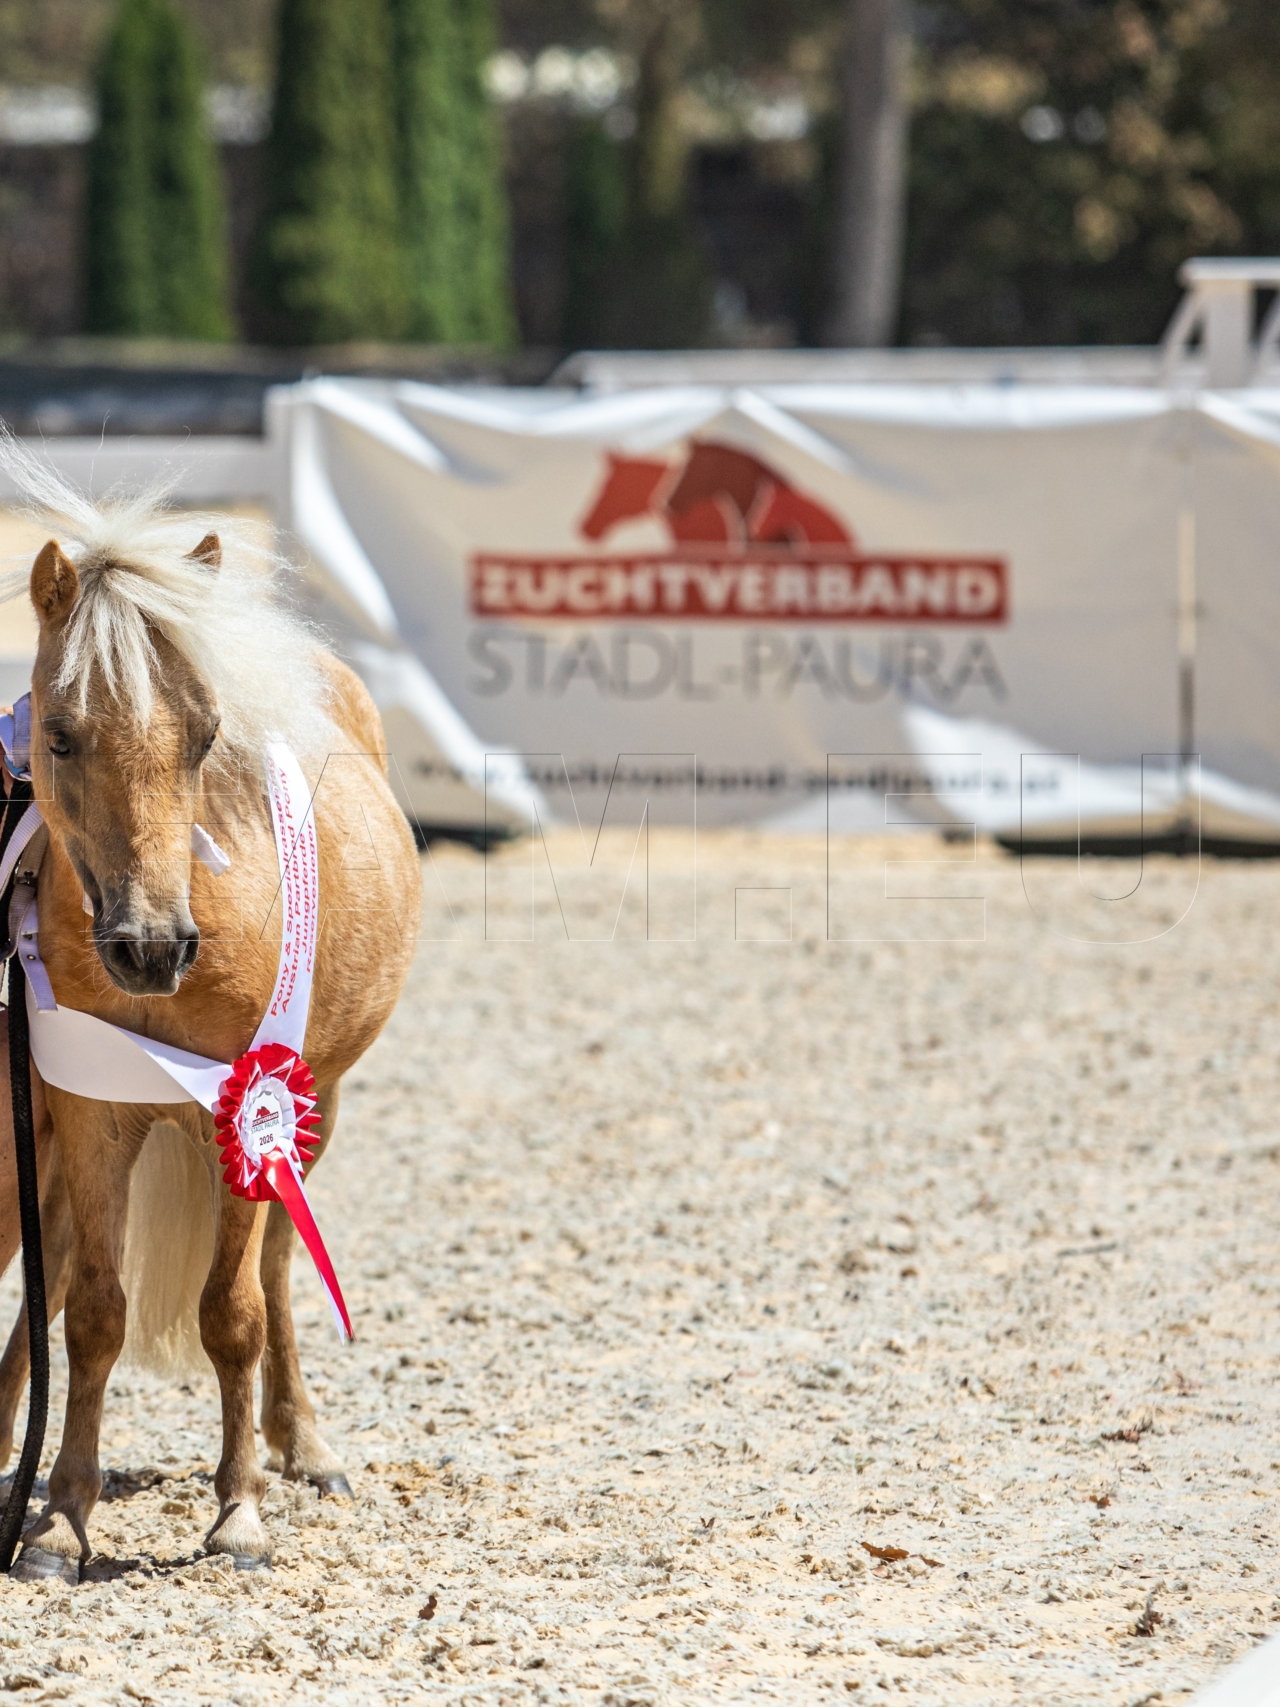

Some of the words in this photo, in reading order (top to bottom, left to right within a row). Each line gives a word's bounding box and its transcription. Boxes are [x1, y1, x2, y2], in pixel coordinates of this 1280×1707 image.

[480, 565, 1000, 614] ZUCHTVERBAND
[468, 628, 1008, 701] STADL-PAURA
[279, 767, 293, 819] Pony
[287, 825, 301, 916] Partbred
[299, 833, 311, 954] Jungpferde
[306, 820, 317, 973] Reservesieger
[270, 963, 289, 1016] Pony
[284, 942, 291, 956] &
[281, 923, 301, 1014] Austrian
[259, 1133, 273, 1146] 2026
